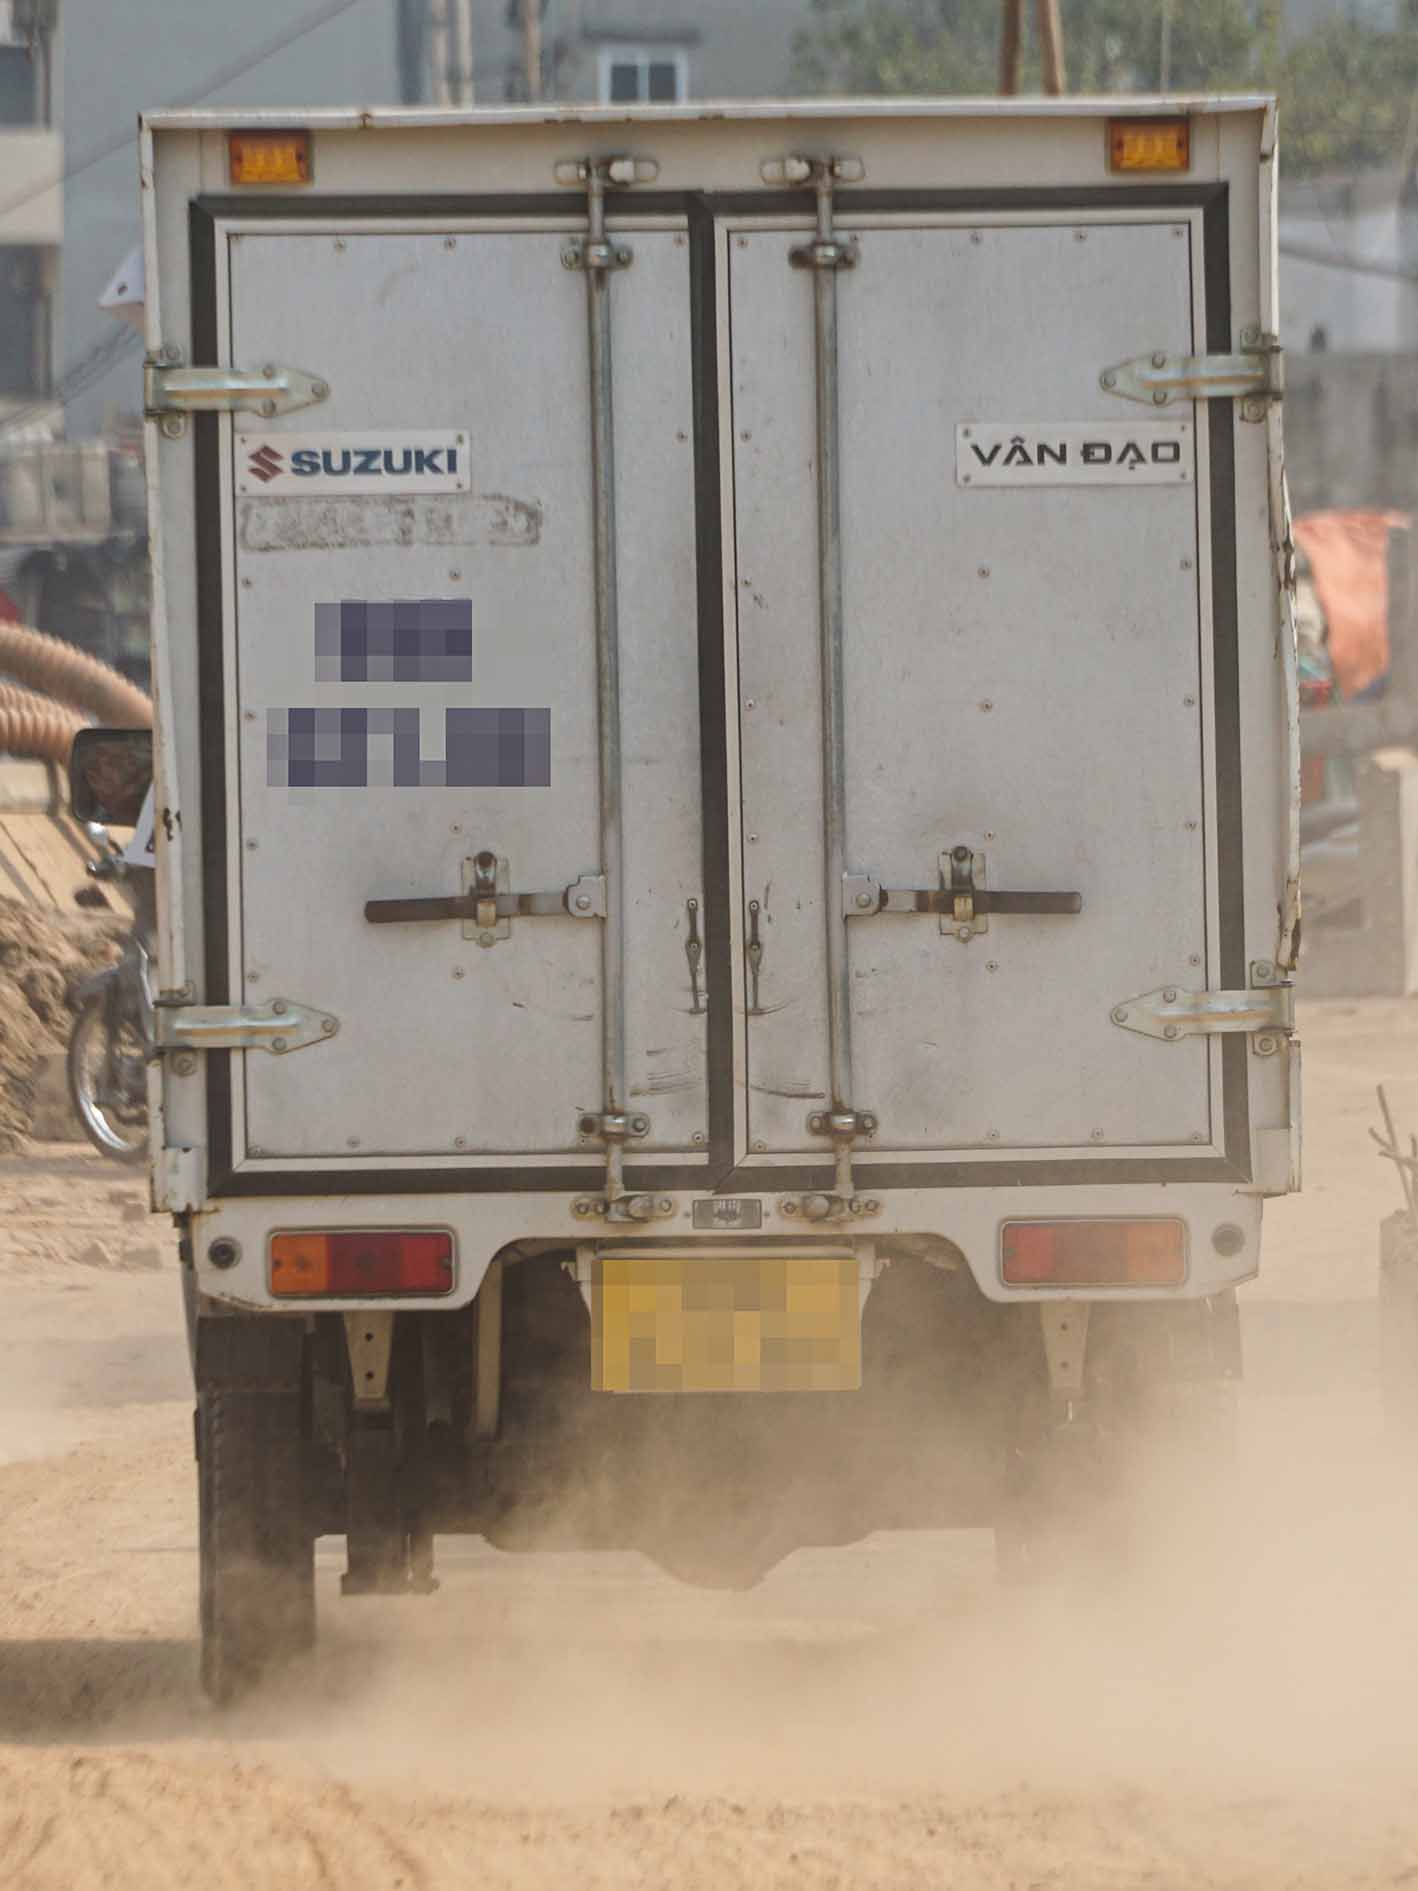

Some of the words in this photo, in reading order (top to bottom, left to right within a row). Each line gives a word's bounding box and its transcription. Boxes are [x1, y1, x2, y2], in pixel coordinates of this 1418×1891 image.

[291, 448, 457, 476] SUZUKI
[970, 435, 1067, 467] VÂN
[1080, 440, 1181, 471] ĐẠO
